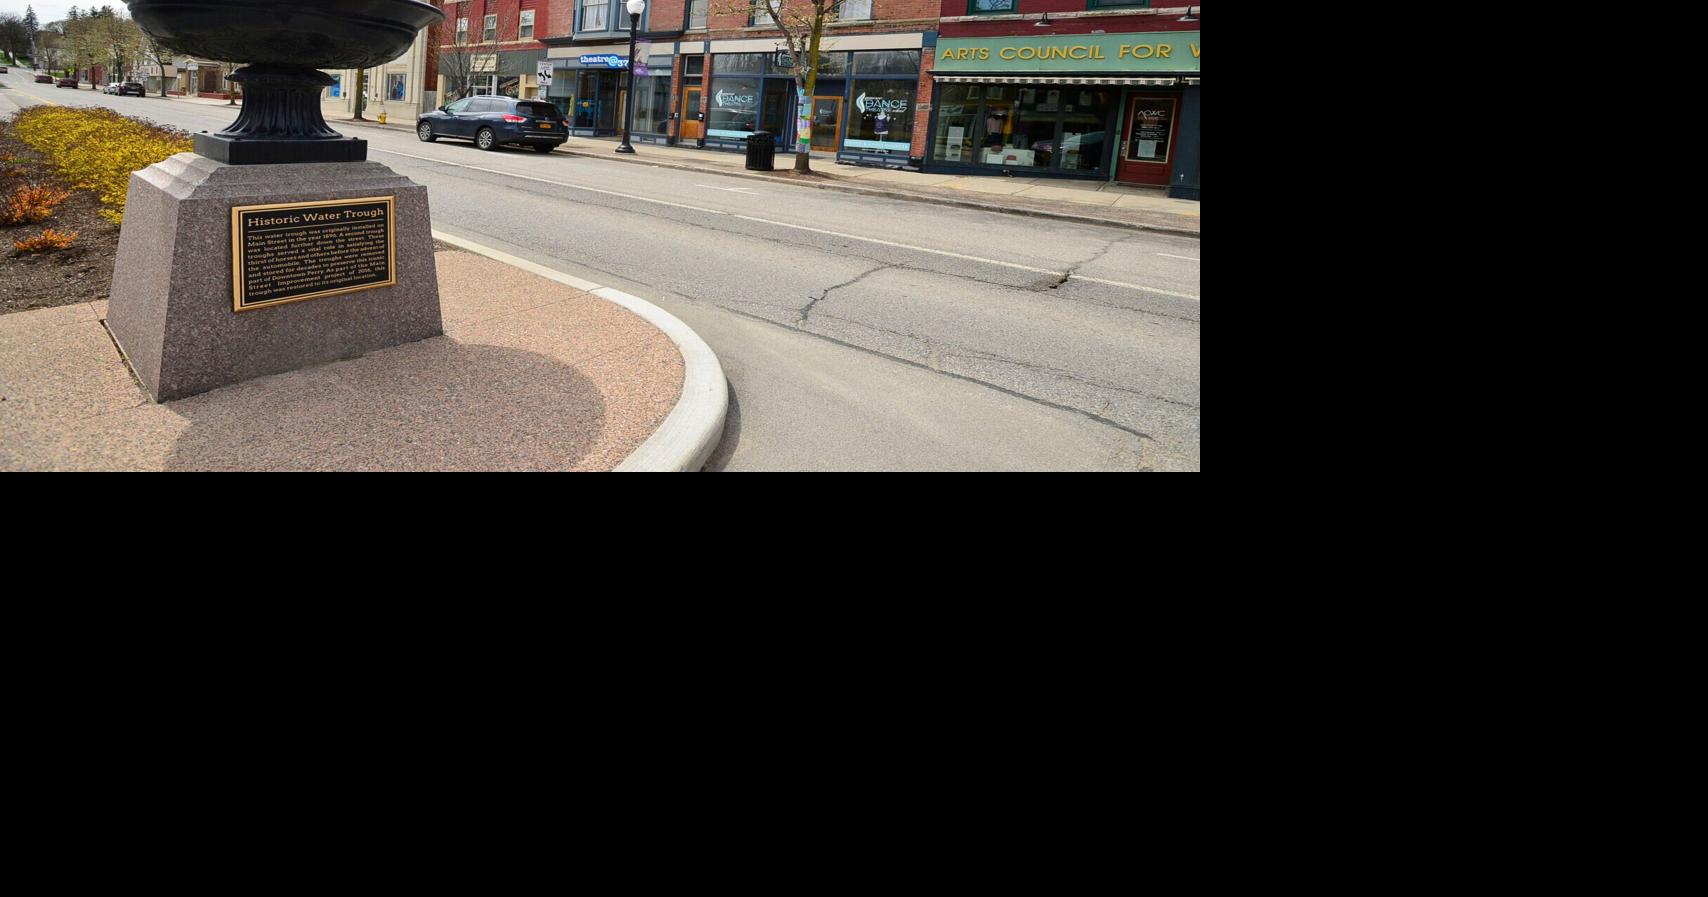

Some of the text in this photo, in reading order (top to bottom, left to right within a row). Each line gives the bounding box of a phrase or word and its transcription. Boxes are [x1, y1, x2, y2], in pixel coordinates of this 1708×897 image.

[941, 44, 1172, 60] ARTS COUNCIL FOR
[580, 56, 629, 67] theatre@37
[866, 100, 907, 108] DANCE
[248, 208, 383, 226] Historic Water Trough
